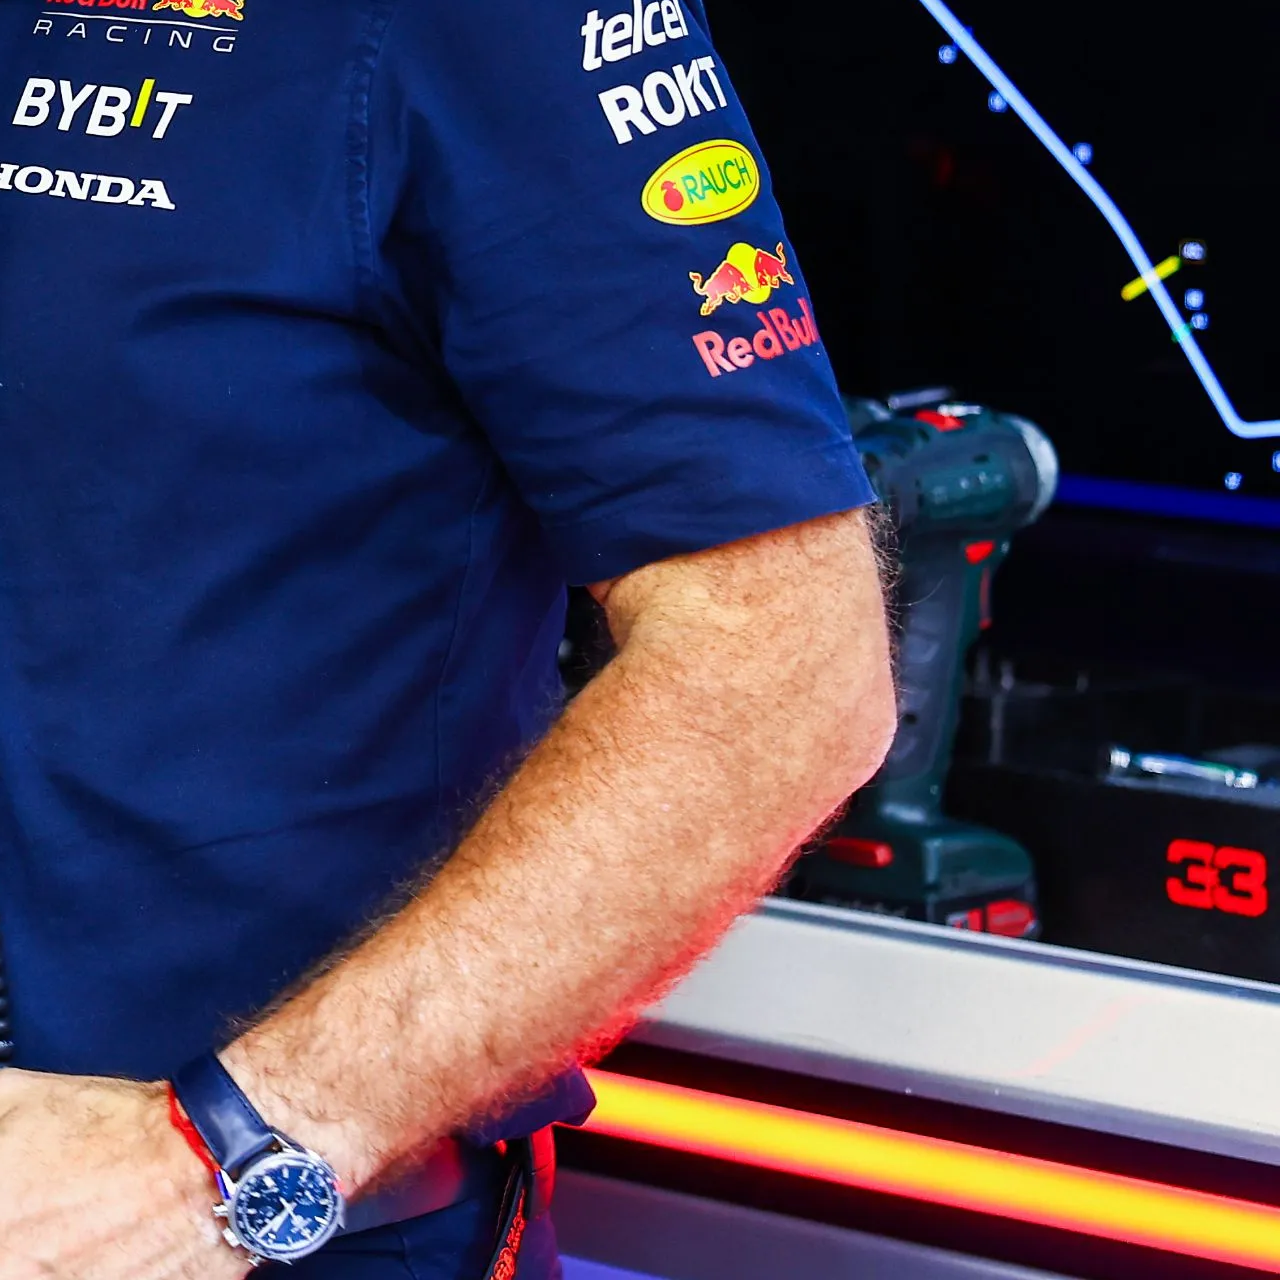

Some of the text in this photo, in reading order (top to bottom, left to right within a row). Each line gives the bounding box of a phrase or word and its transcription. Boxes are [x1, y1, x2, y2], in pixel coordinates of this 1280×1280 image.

[33, 18, 237, 53] RACING
[12, 77, 193, 140] BYBIT
[598, 55, 728, 145] ROKT
[681, 156, 751, 204] RAUCH
[1166, 838, 1269, 918] 33
